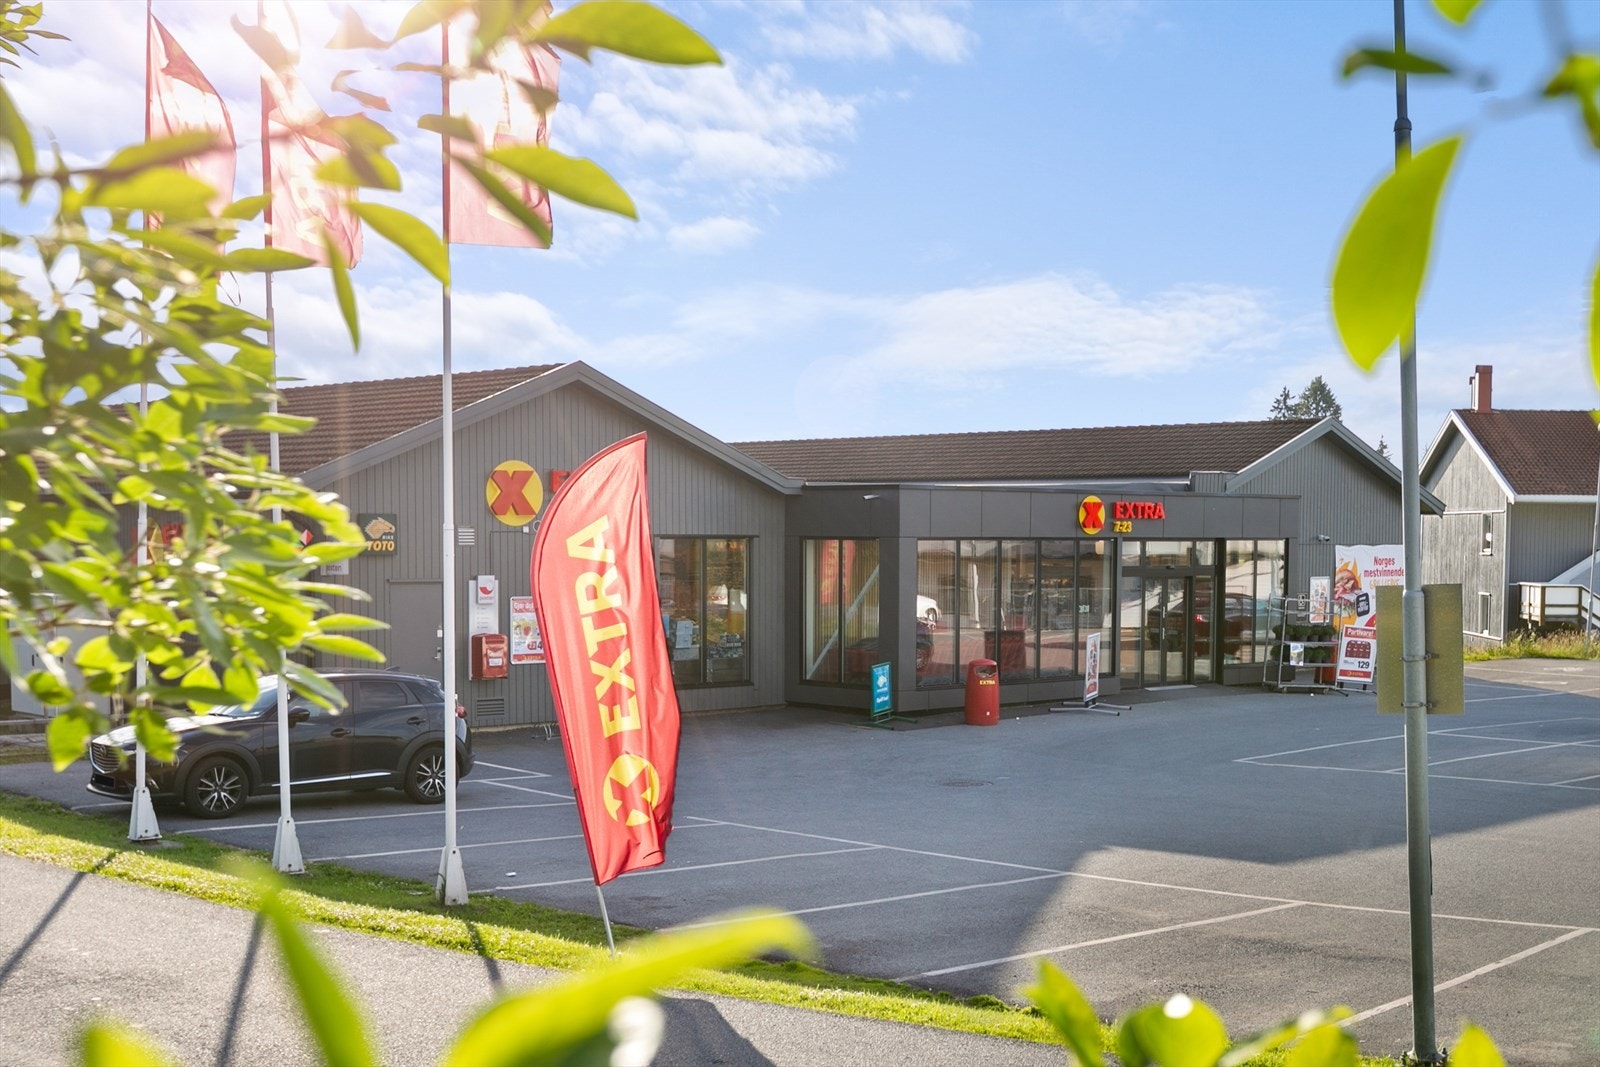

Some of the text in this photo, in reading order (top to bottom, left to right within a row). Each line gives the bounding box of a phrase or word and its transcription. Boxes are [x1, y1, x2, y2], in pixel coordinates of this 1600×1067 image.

[1114, 502, 1166, 520] EXTRA
[1113, 521, 1133, 533] 7-23
[367, 541, 395, 551] TOTO
[1373, 557, 1395, 567] Norges
[566, 514, 642, 740] EXTRA
[1357, 660, 1370, 669] 129
